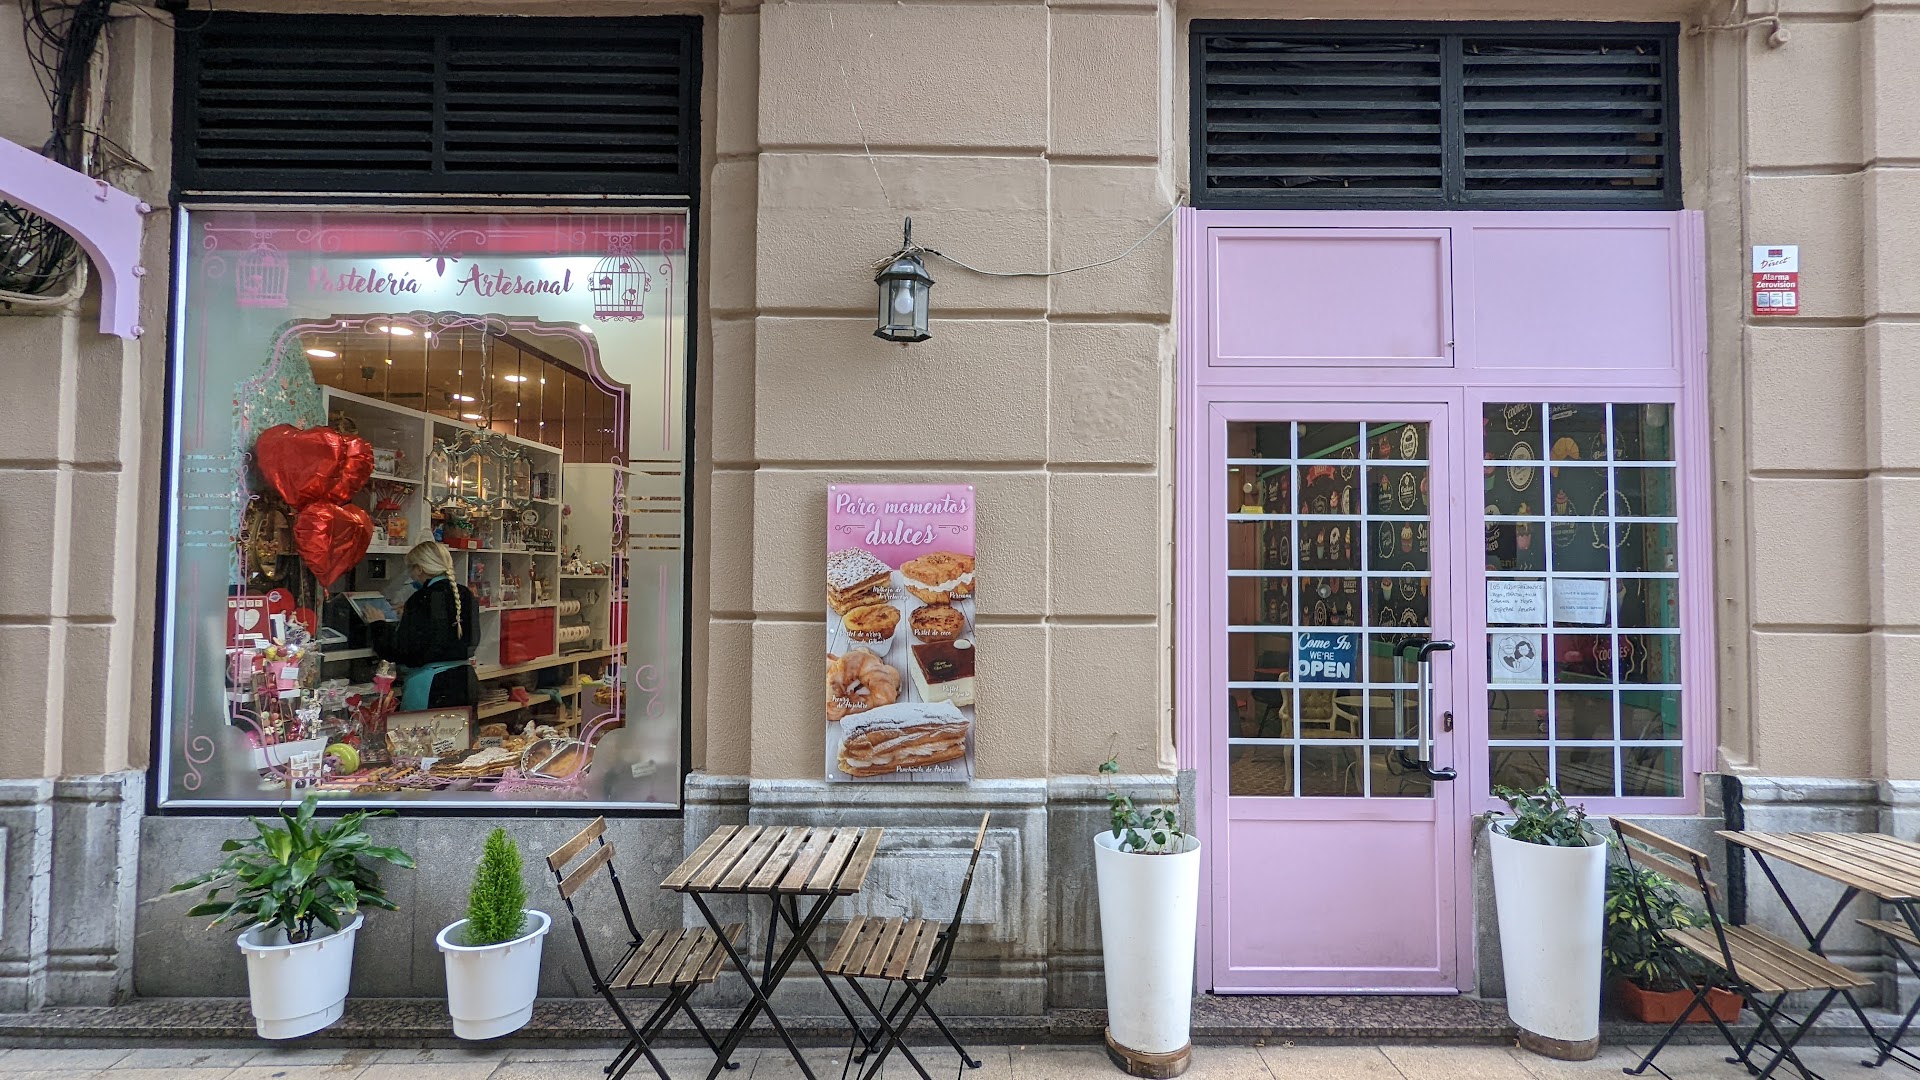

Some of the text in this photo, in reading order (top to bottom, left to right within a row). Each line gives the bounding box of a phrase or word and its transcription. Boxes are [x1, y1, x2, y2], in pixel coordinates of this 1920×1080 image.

[308, 263, 574, 297] Pastelería Artesanal
[836, 493, 970, 516] Para momentos
[865, 519, 937, 546] dulces
[914, 628, 931, 636] Pastel
[932, 628, 939, 636] de
[1298, 632, 1352, 651] Come In
[1310, 651, 1335, 660] WE'RE
[1599, 646, 1628, 661] COOES
[1299, 660, 1351, 679] OPEN
